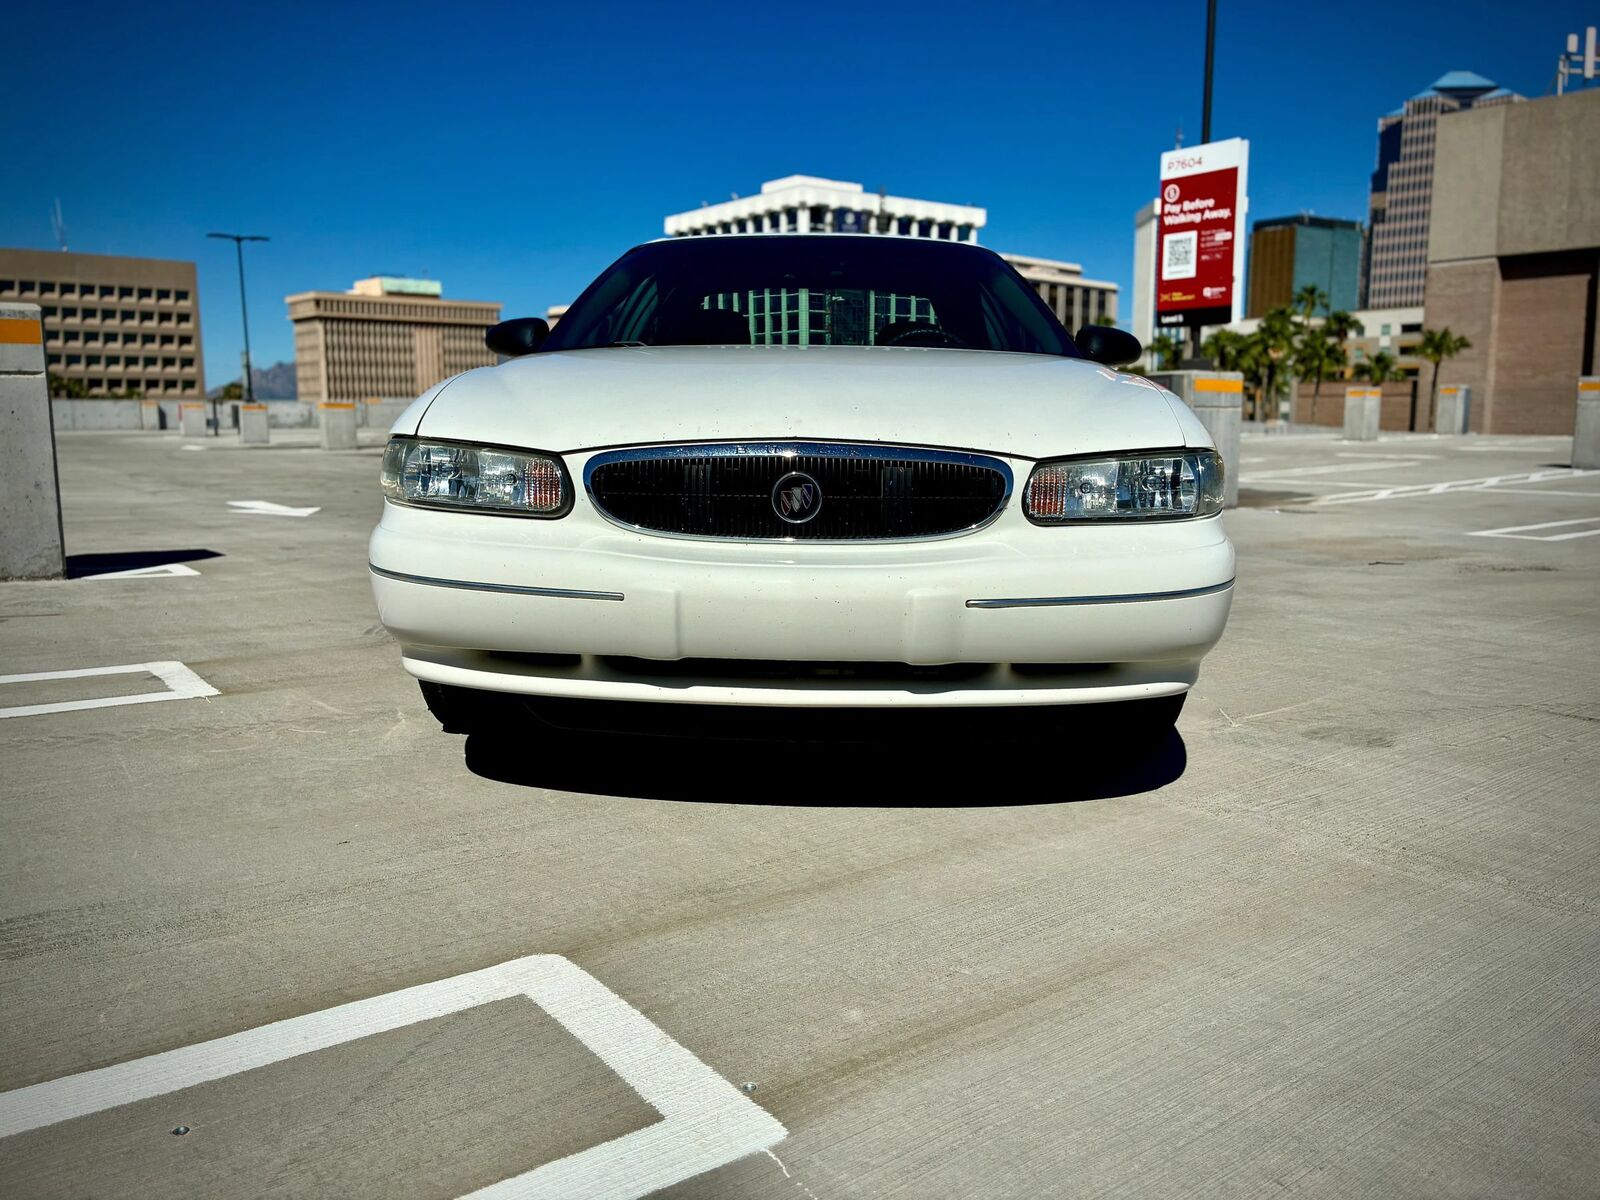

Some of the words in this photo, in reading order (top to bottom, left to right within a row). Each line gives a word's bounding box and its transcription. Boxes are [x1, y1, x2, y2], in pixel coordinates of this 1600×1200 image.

[1167, 156, 1202, 170] P7604
[1164, 203, 1182, 214] Pay
[1182, 198, 1215, 211] Before
[1163, 212, 1202, 226] Walking
